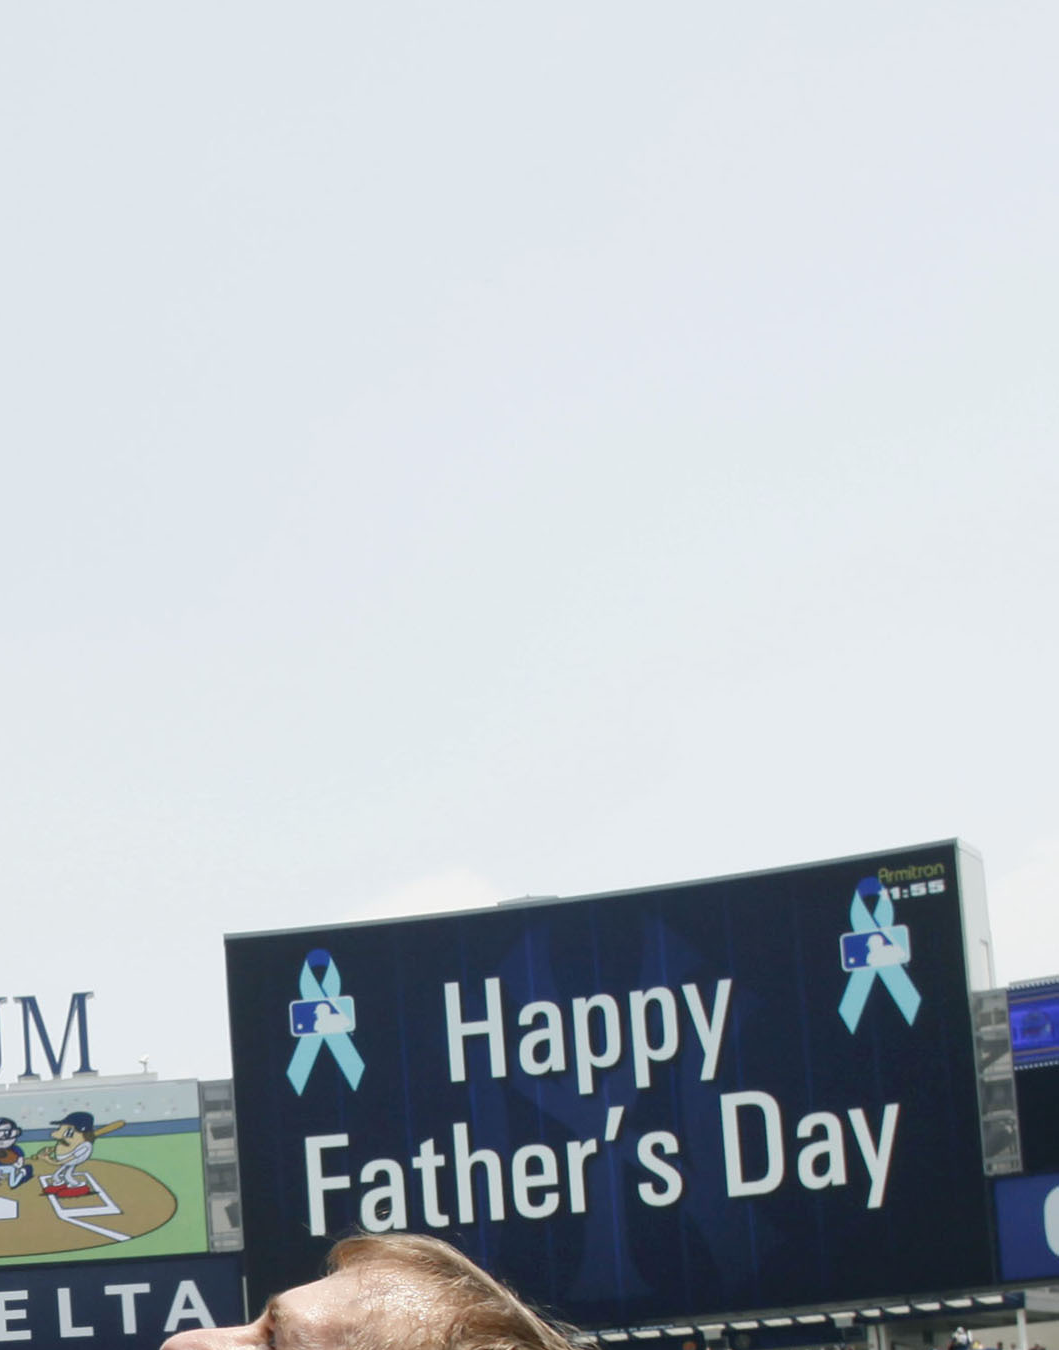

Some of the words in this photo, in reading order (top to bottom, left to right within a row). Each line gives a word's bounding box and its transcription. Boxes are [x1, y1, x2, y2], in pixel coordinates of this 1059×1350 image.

[878, 863, 945, 884] Armitron
[444, 977, 733, 1095] Happy
[304, 1107, 684, 1238] Father's
[720, 1090, 901, 1210] Day
